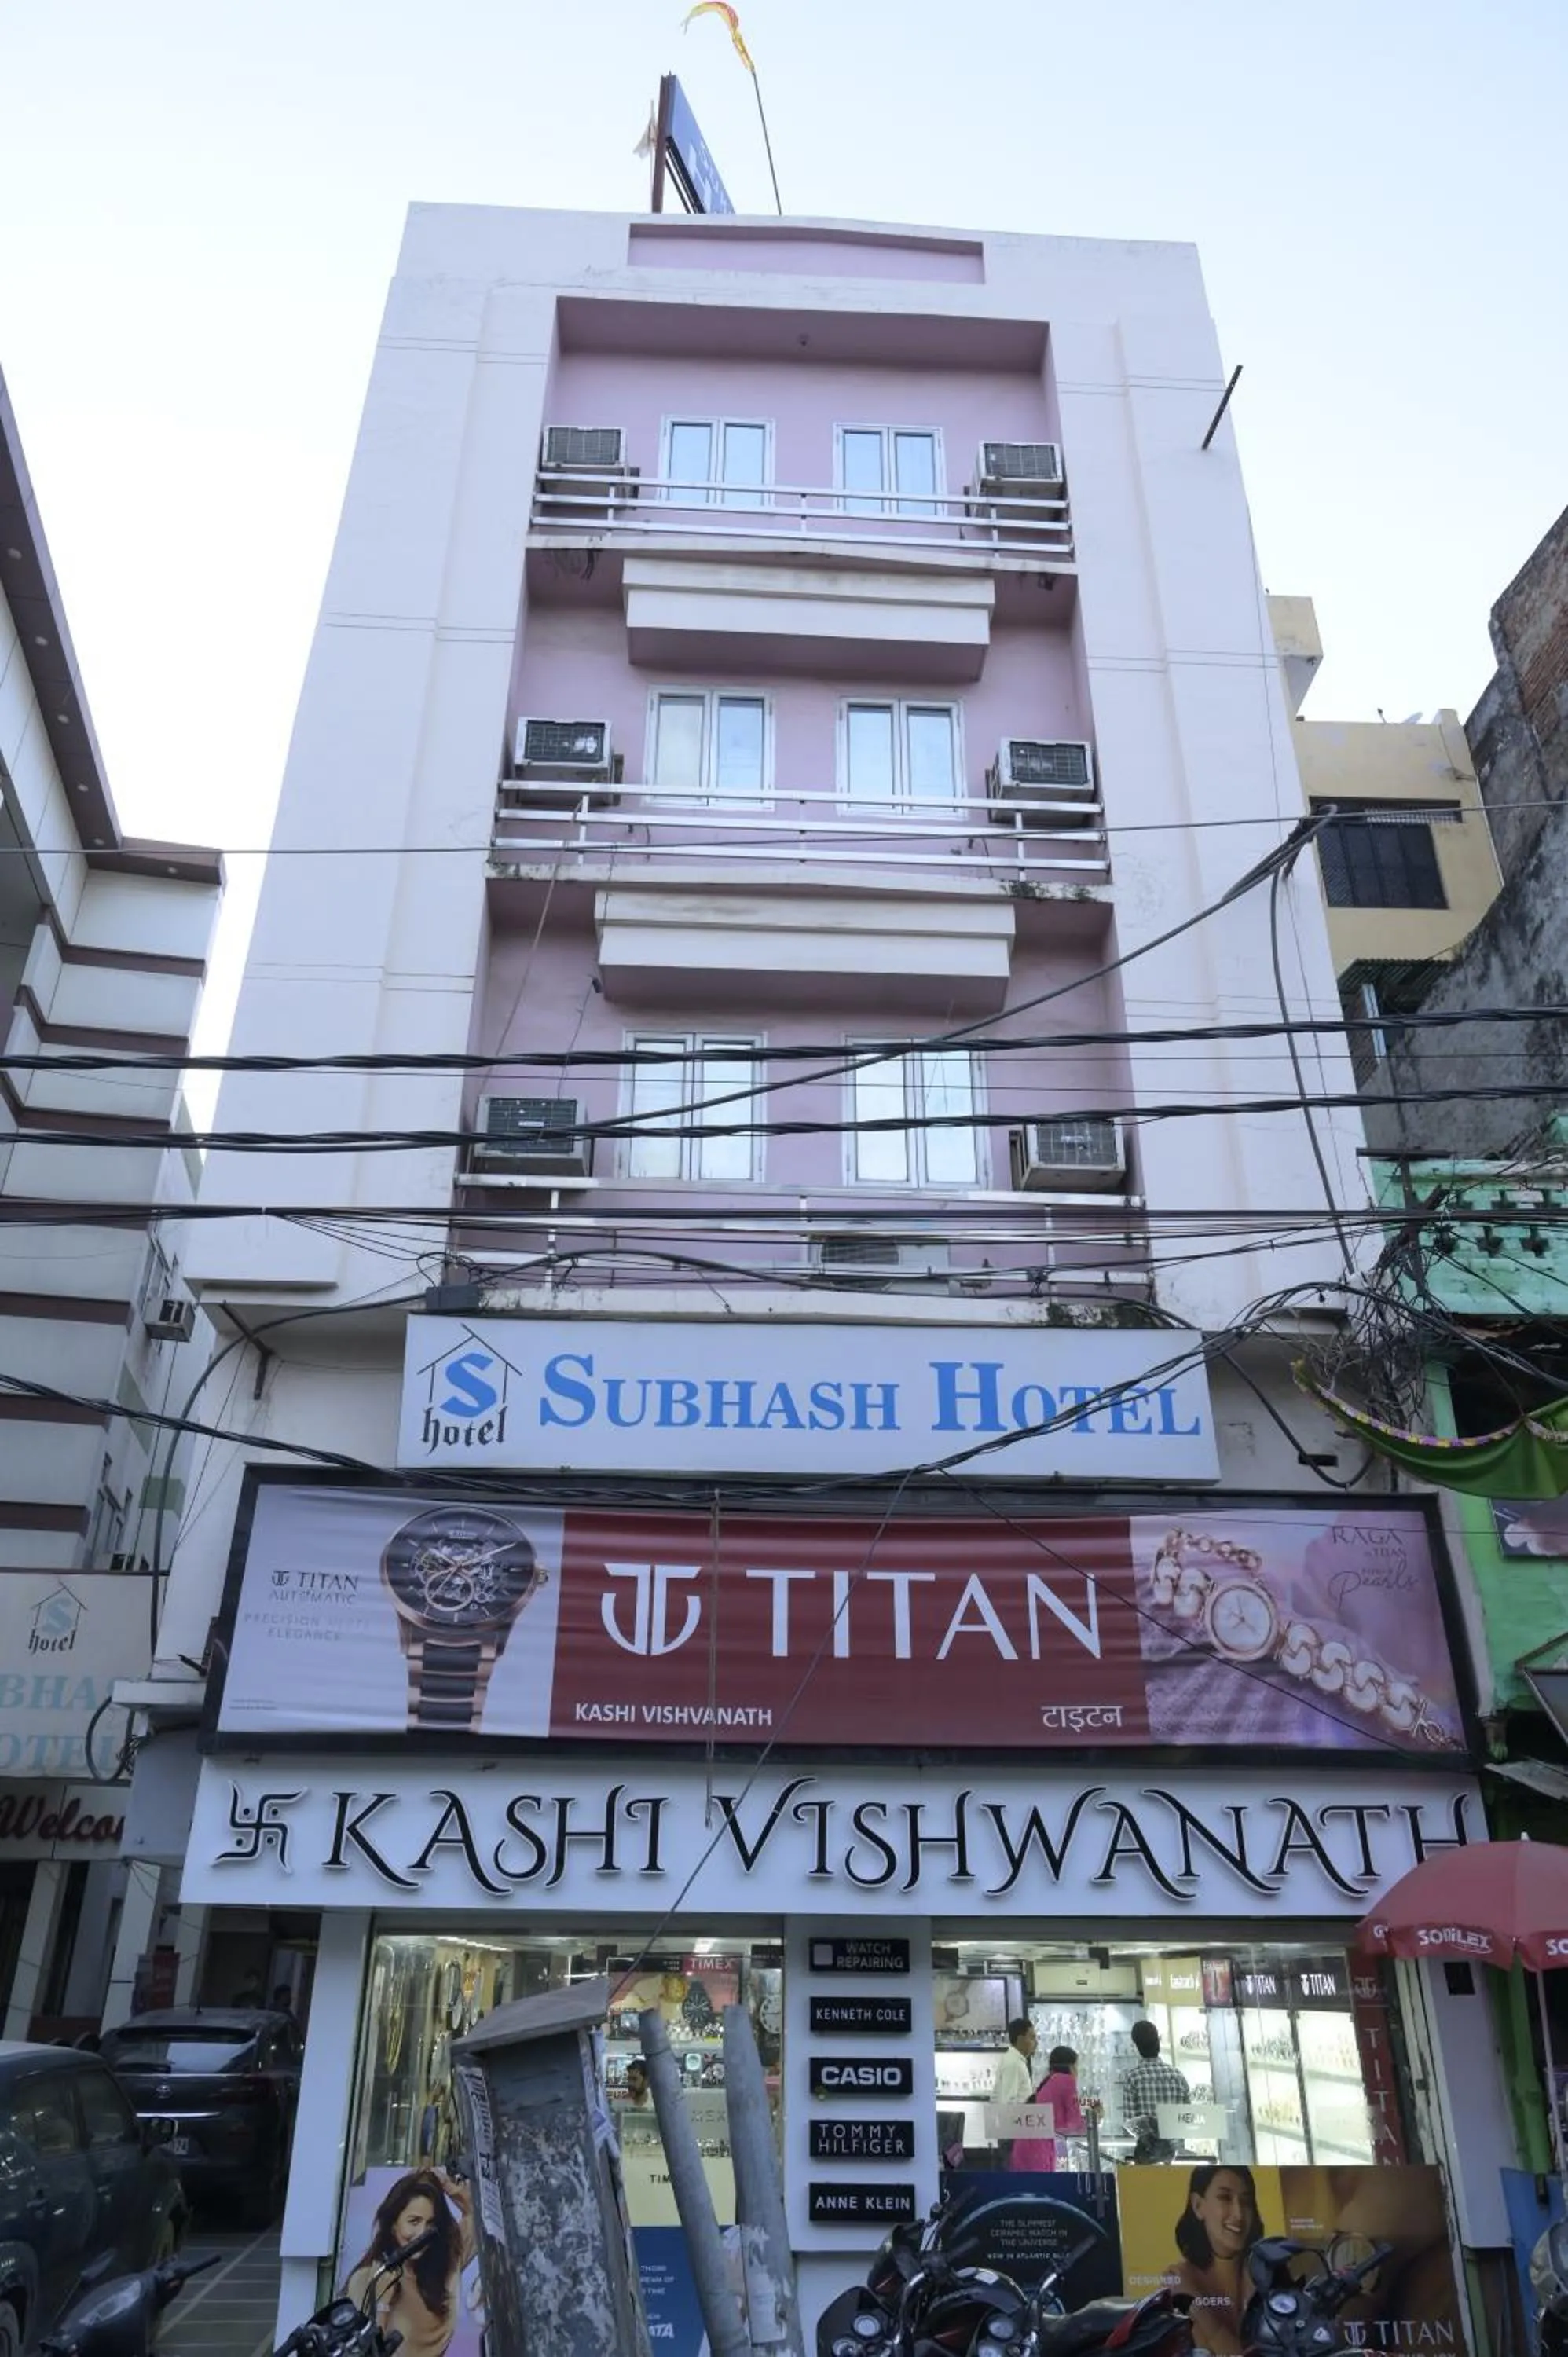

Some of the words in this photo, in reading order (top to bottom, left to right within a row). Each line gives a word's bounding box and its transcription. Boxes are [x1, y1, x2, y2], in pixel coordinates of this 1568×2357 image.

[439, 1352, 499, 1418] S
[540, 1354, 902, 1431] SUBHASH
[929, 1362, 1201, 1436] HOTEL
[422, 1406, 507, 1456] hotel
[1332, 1526, 1403, 1545] RAGA
[297, 1572, 359, 1591] TITAN
[269, 1590, 358, 1605] AUTOMATIC
[244, 1613, 321, 1627] PRECISION
[746, 1569, 1103, 1661] TITAN
[28, 1629, 78, 1655] hotel
[268, 1627, 343, 1642] ELEGANCE
[575, 1702, 636, 1724] KASHI
[641, 1704, 773, 1727] VISHVANATH
[1040, 1704, 1123, 1732] टाइटन
[321, 1784, 669, 1895] KASHI
[711, 1777, 1469, 1899] VISHWANATH
[845, 1942, 892, 1955] WATCH
[690, 1956, 734, 1970] TIMEX
[836, 1955, 904, 1970] REPAIRING
[815, 2008, 872, 2022] KENNETH
[876, 2009, 907, 2022] COLE
[820, 2066, 903, 2087] CASIO
[819, 2123, 896, 2139] TOMMY
[818, 2139, 906, 2154] HILFIGER
[815, 2195, 859, 2209] ANNE
[865, 2196, 910, 2211] KLEIN
[1373, 2320, 1456, 2346] TITAN
